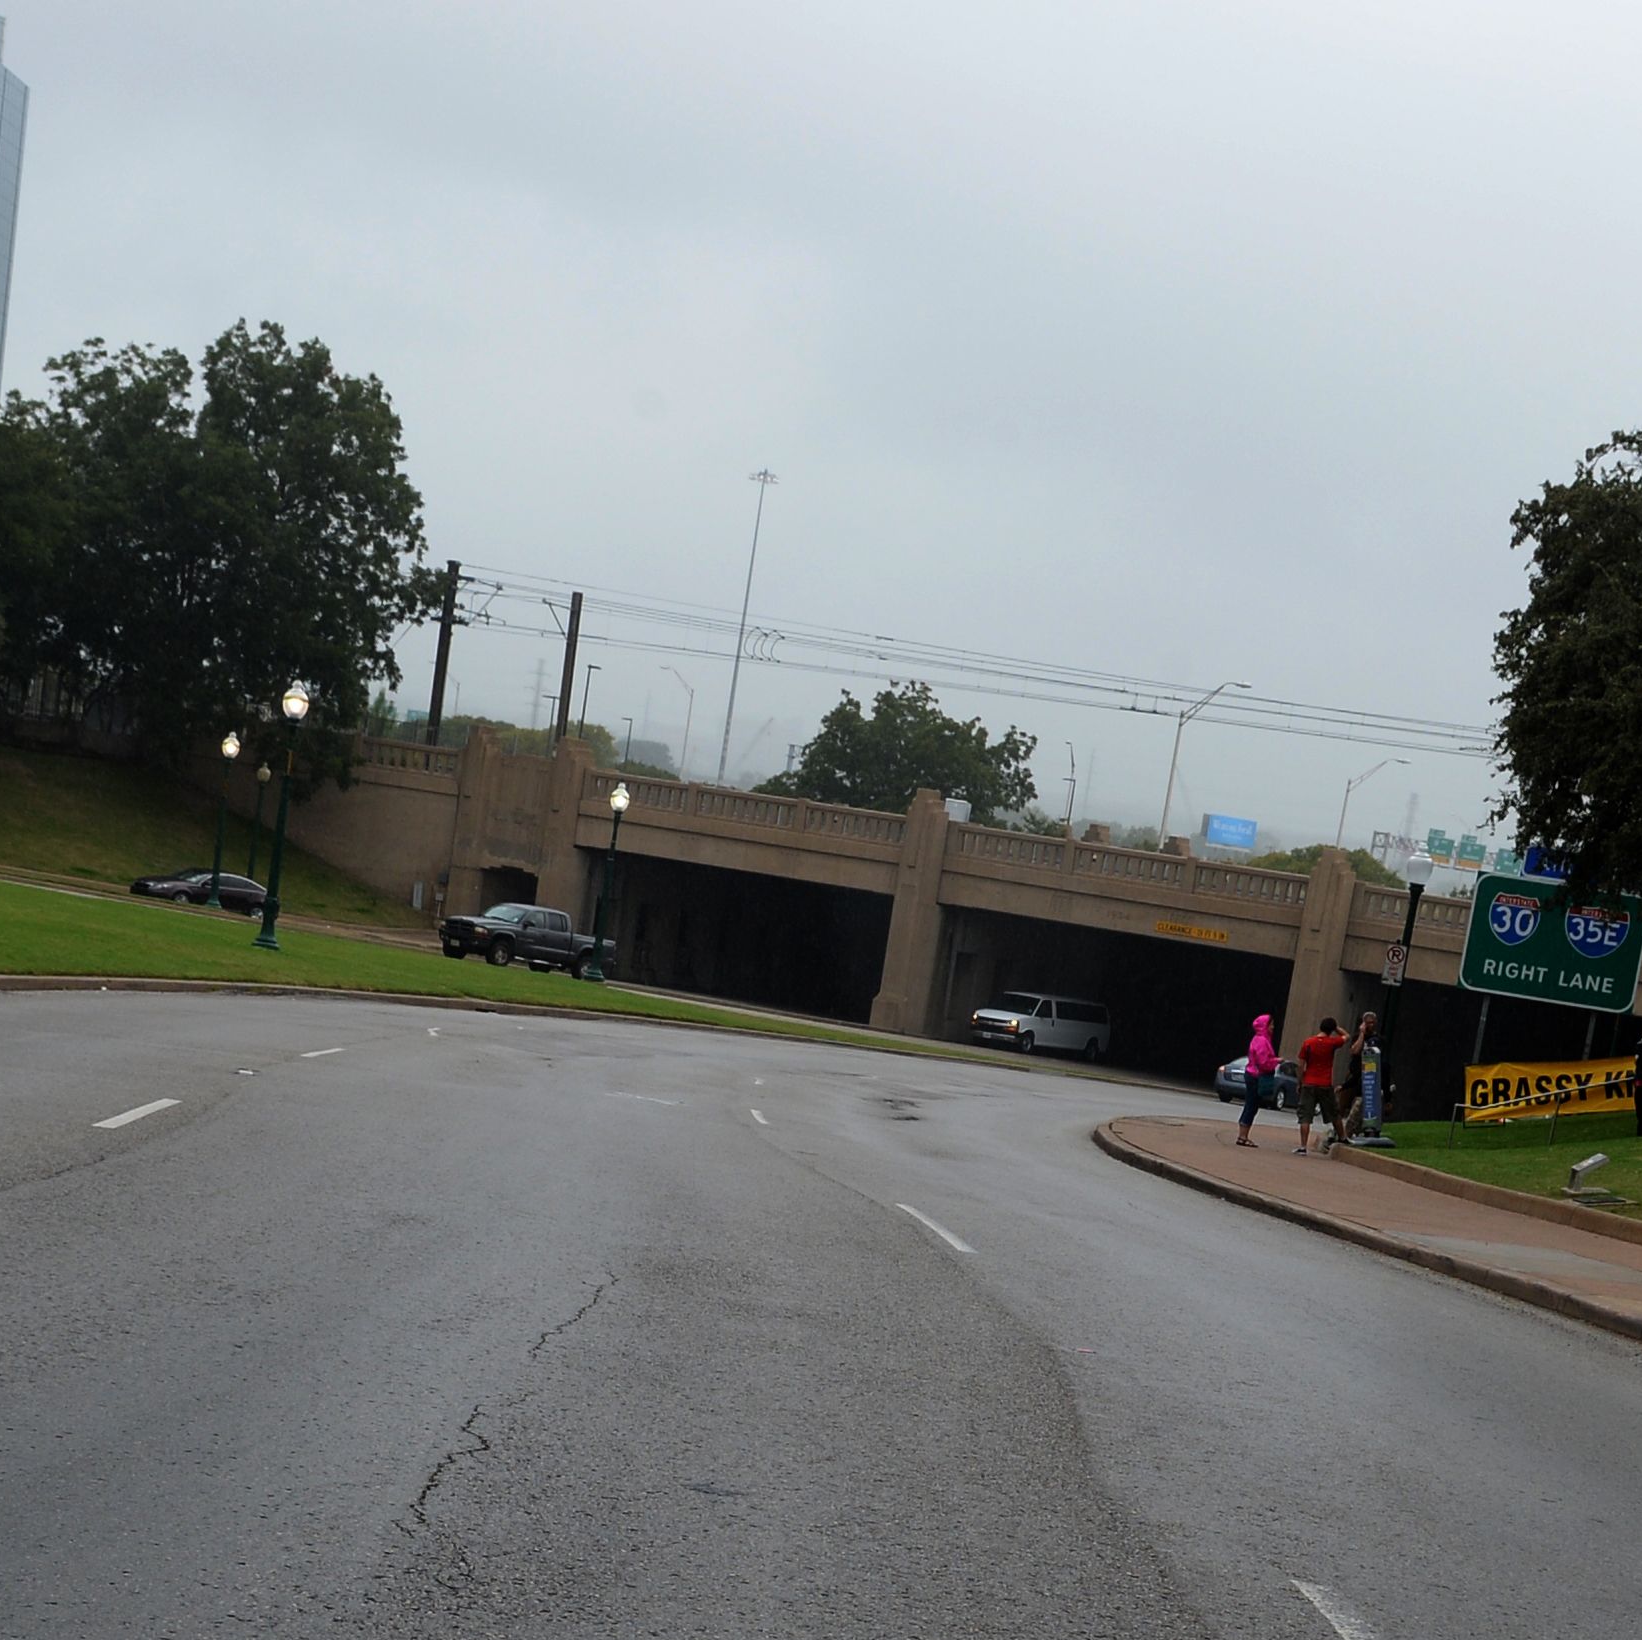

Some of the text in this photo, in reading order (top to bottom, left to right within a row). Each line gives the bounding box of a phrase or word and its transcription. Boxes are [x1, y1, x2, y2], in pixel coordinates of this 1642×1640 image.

[1499, 896, 1534, 908] INTERSTATE
[1493, 907, 1534, 937] 30
[1569, 917, 1620, 946] 35E
[1483, 958, 1614, 994] RIGHT LANE
[1470, 1071, 1592, 1107] GRASSY
